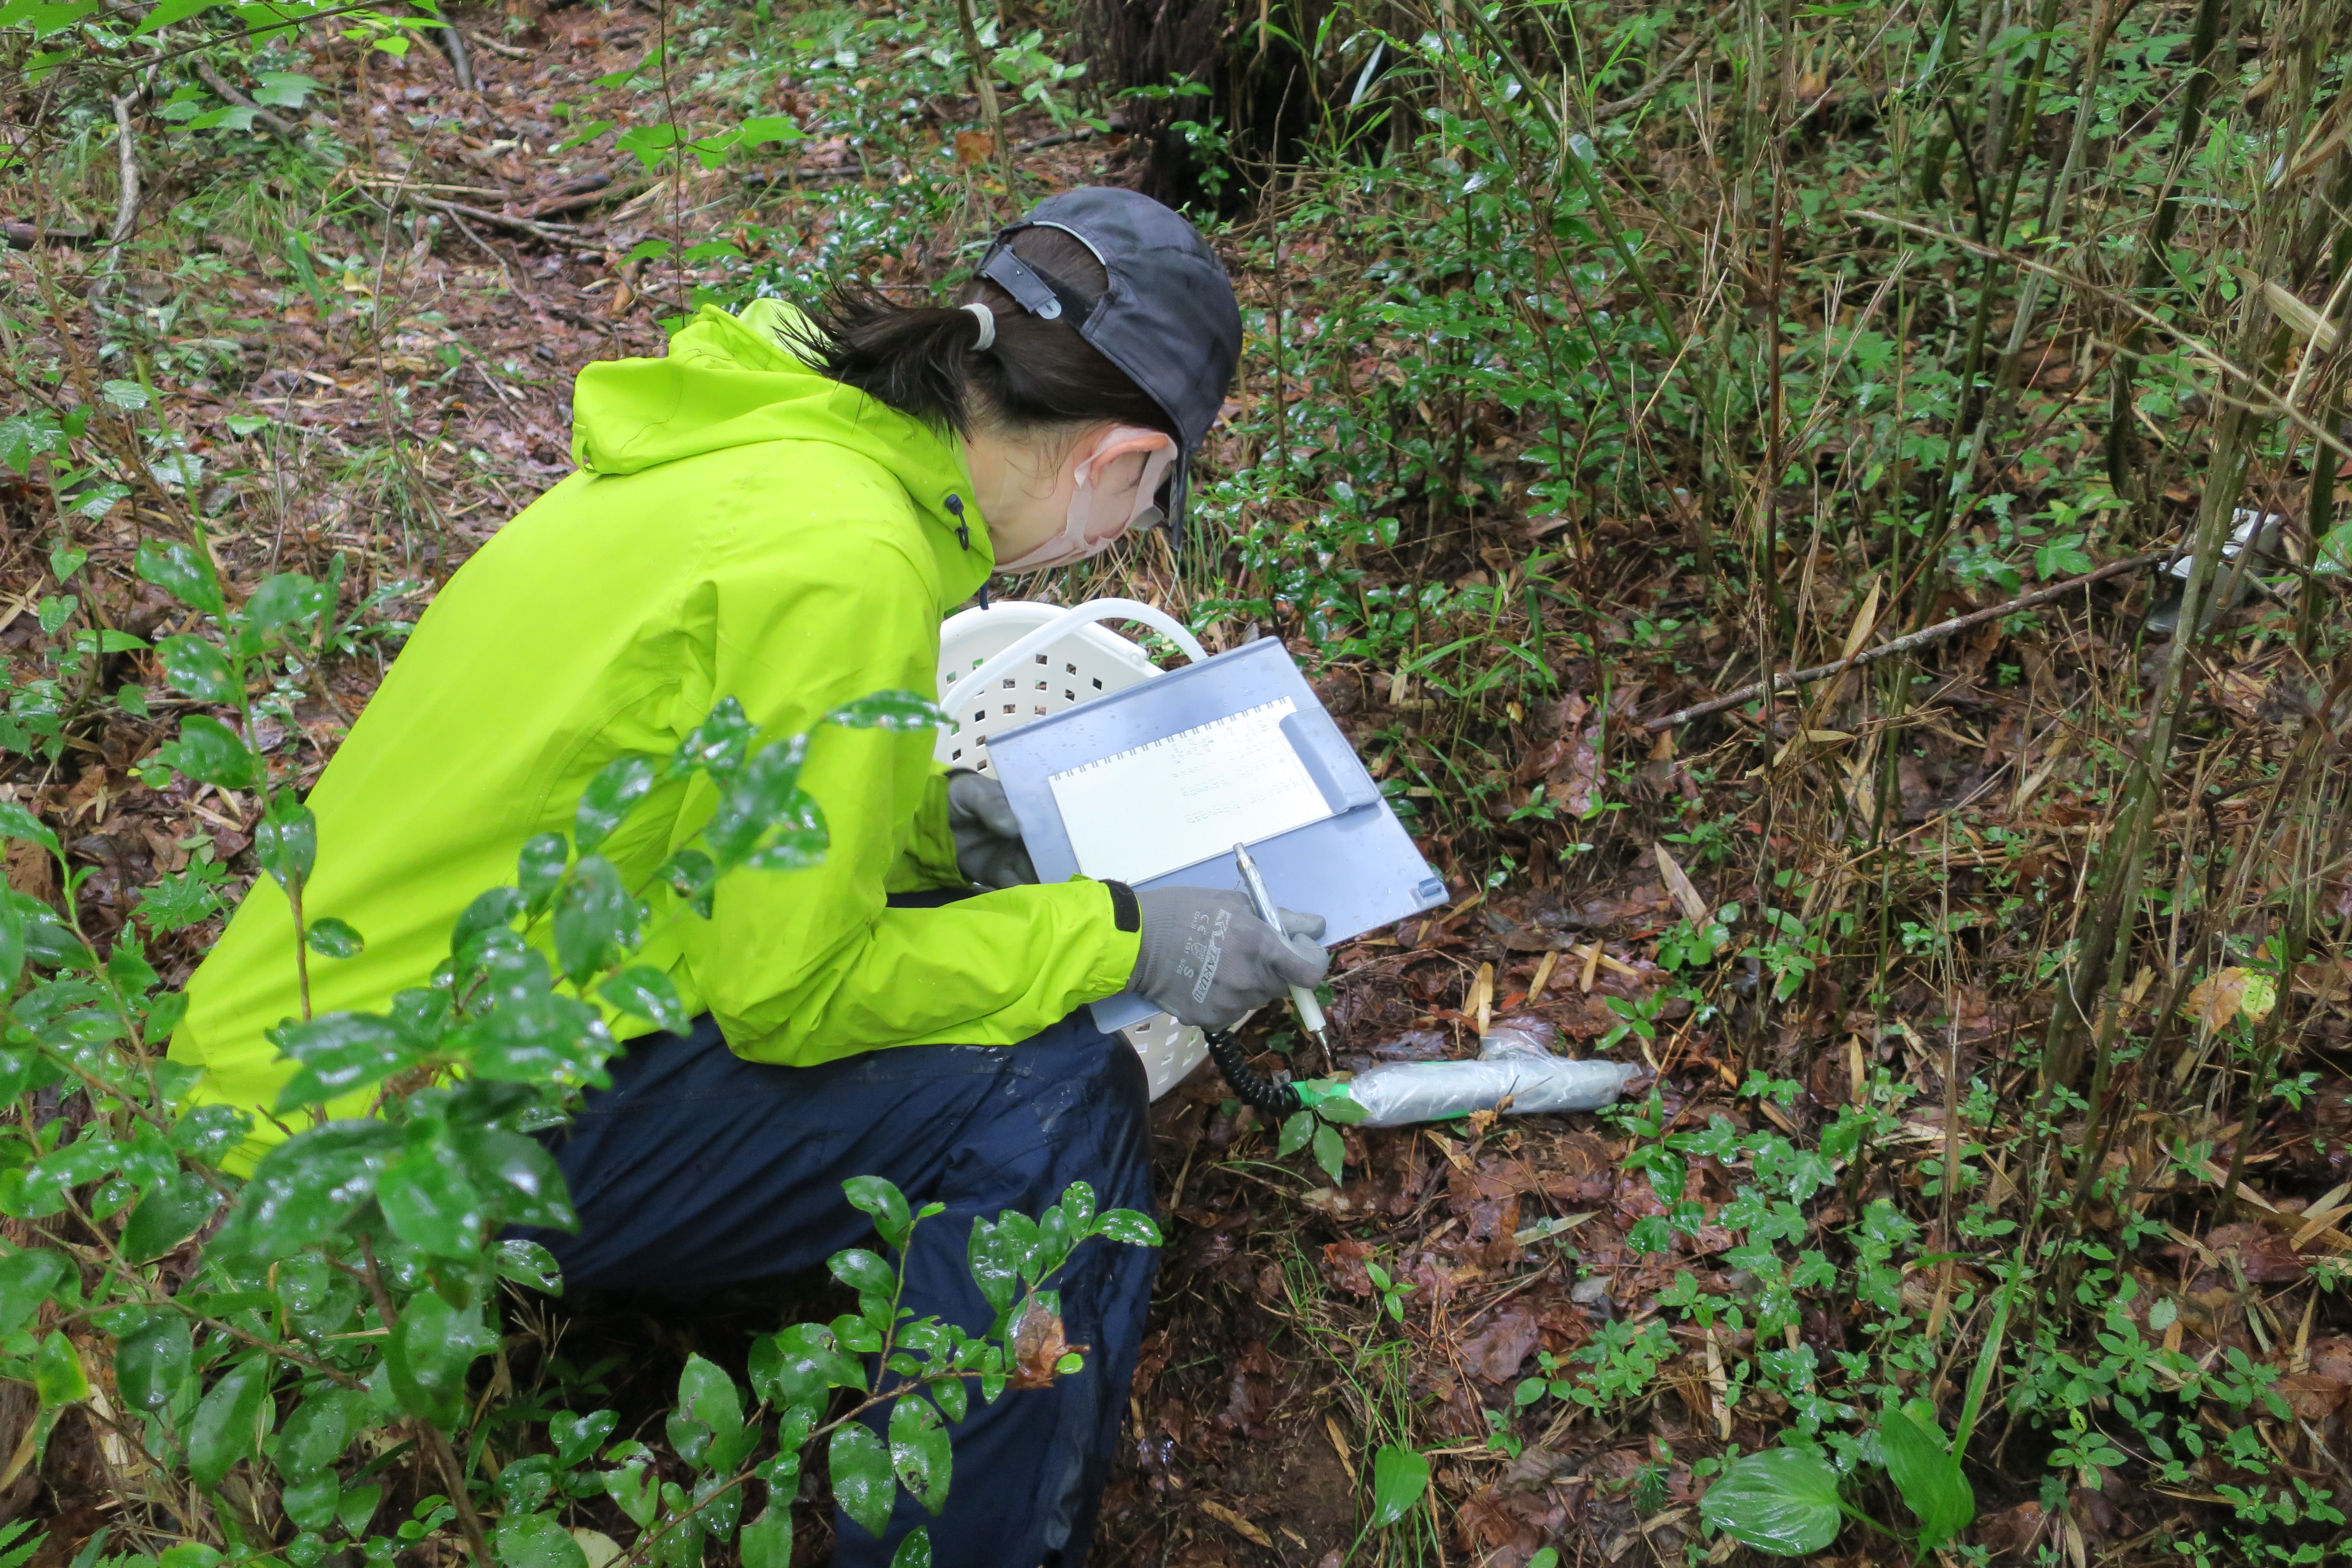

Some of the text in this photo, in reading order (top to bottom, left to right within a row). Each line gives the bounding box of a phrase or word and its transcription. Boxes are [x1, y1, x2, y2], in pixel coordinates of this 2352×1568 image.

[1176, 958, 1186, 975] SIZE
[1183, 965, 1194, 978] S
[1194, 949, 1218, 1000] TAKUMI
